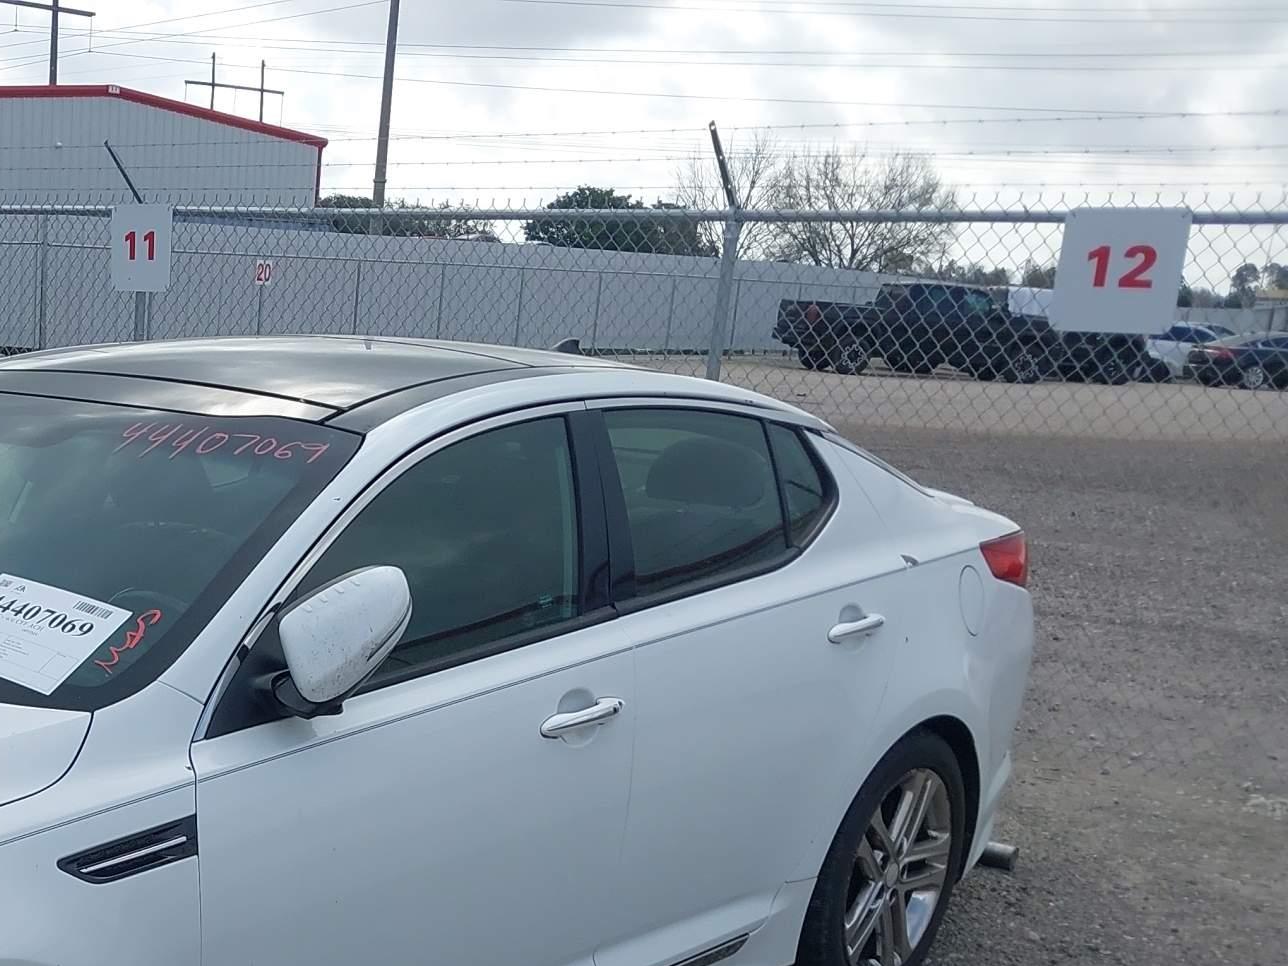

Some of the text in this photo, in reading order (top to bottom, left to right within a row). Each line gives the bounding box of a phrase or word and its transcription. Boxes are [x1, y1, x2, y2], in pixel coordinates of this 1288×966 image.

[124, 230, 155, 261] 11
[256, 262, 272, 282] 20
[1087, 245, 1158, 289] 12
[112, 422, 331, 464] 44407069
